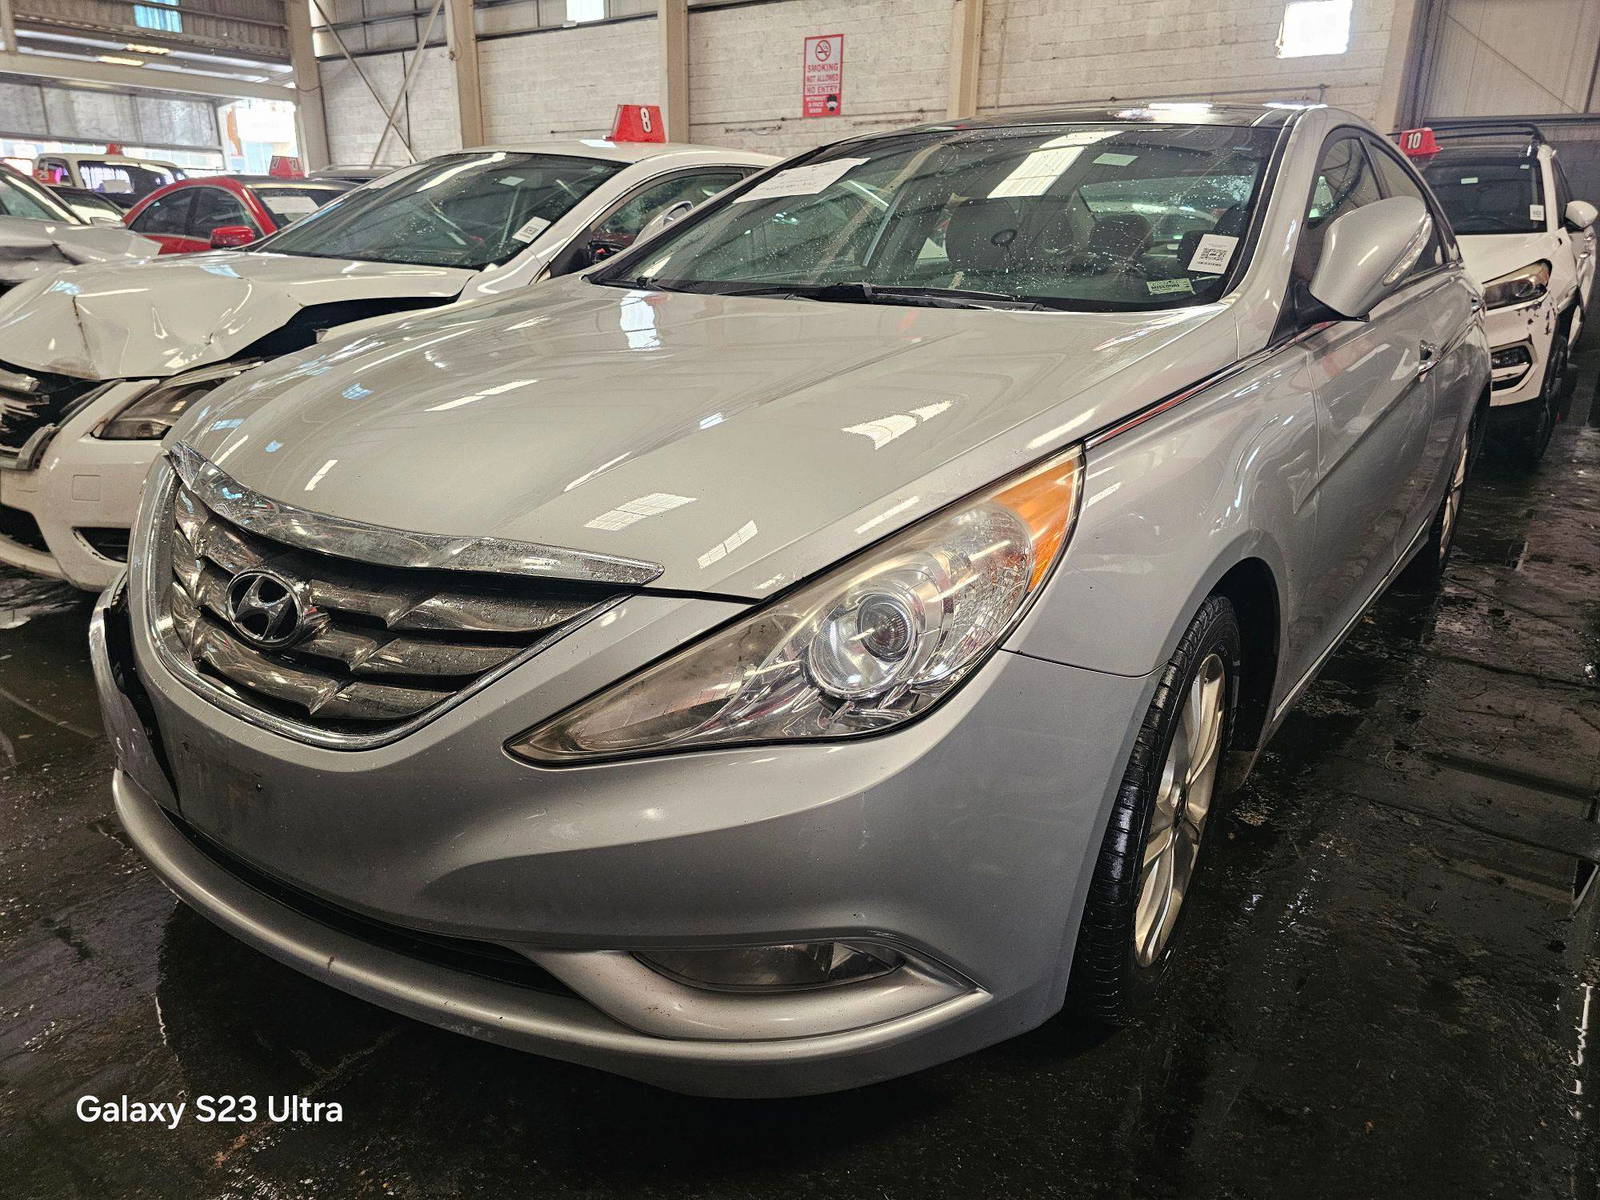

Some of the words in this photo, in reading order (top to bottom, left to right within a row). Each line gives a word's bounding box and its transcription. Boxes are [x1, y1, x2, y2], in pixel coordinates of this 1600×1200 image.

[807, 63, 839, 73] SMOKING
[807, 86, 816, 94] NO
[817, 85, 838, 94] ENTRY
[640, 107, 652, 133] 8
[1407, 132, 1422, 149] 10
